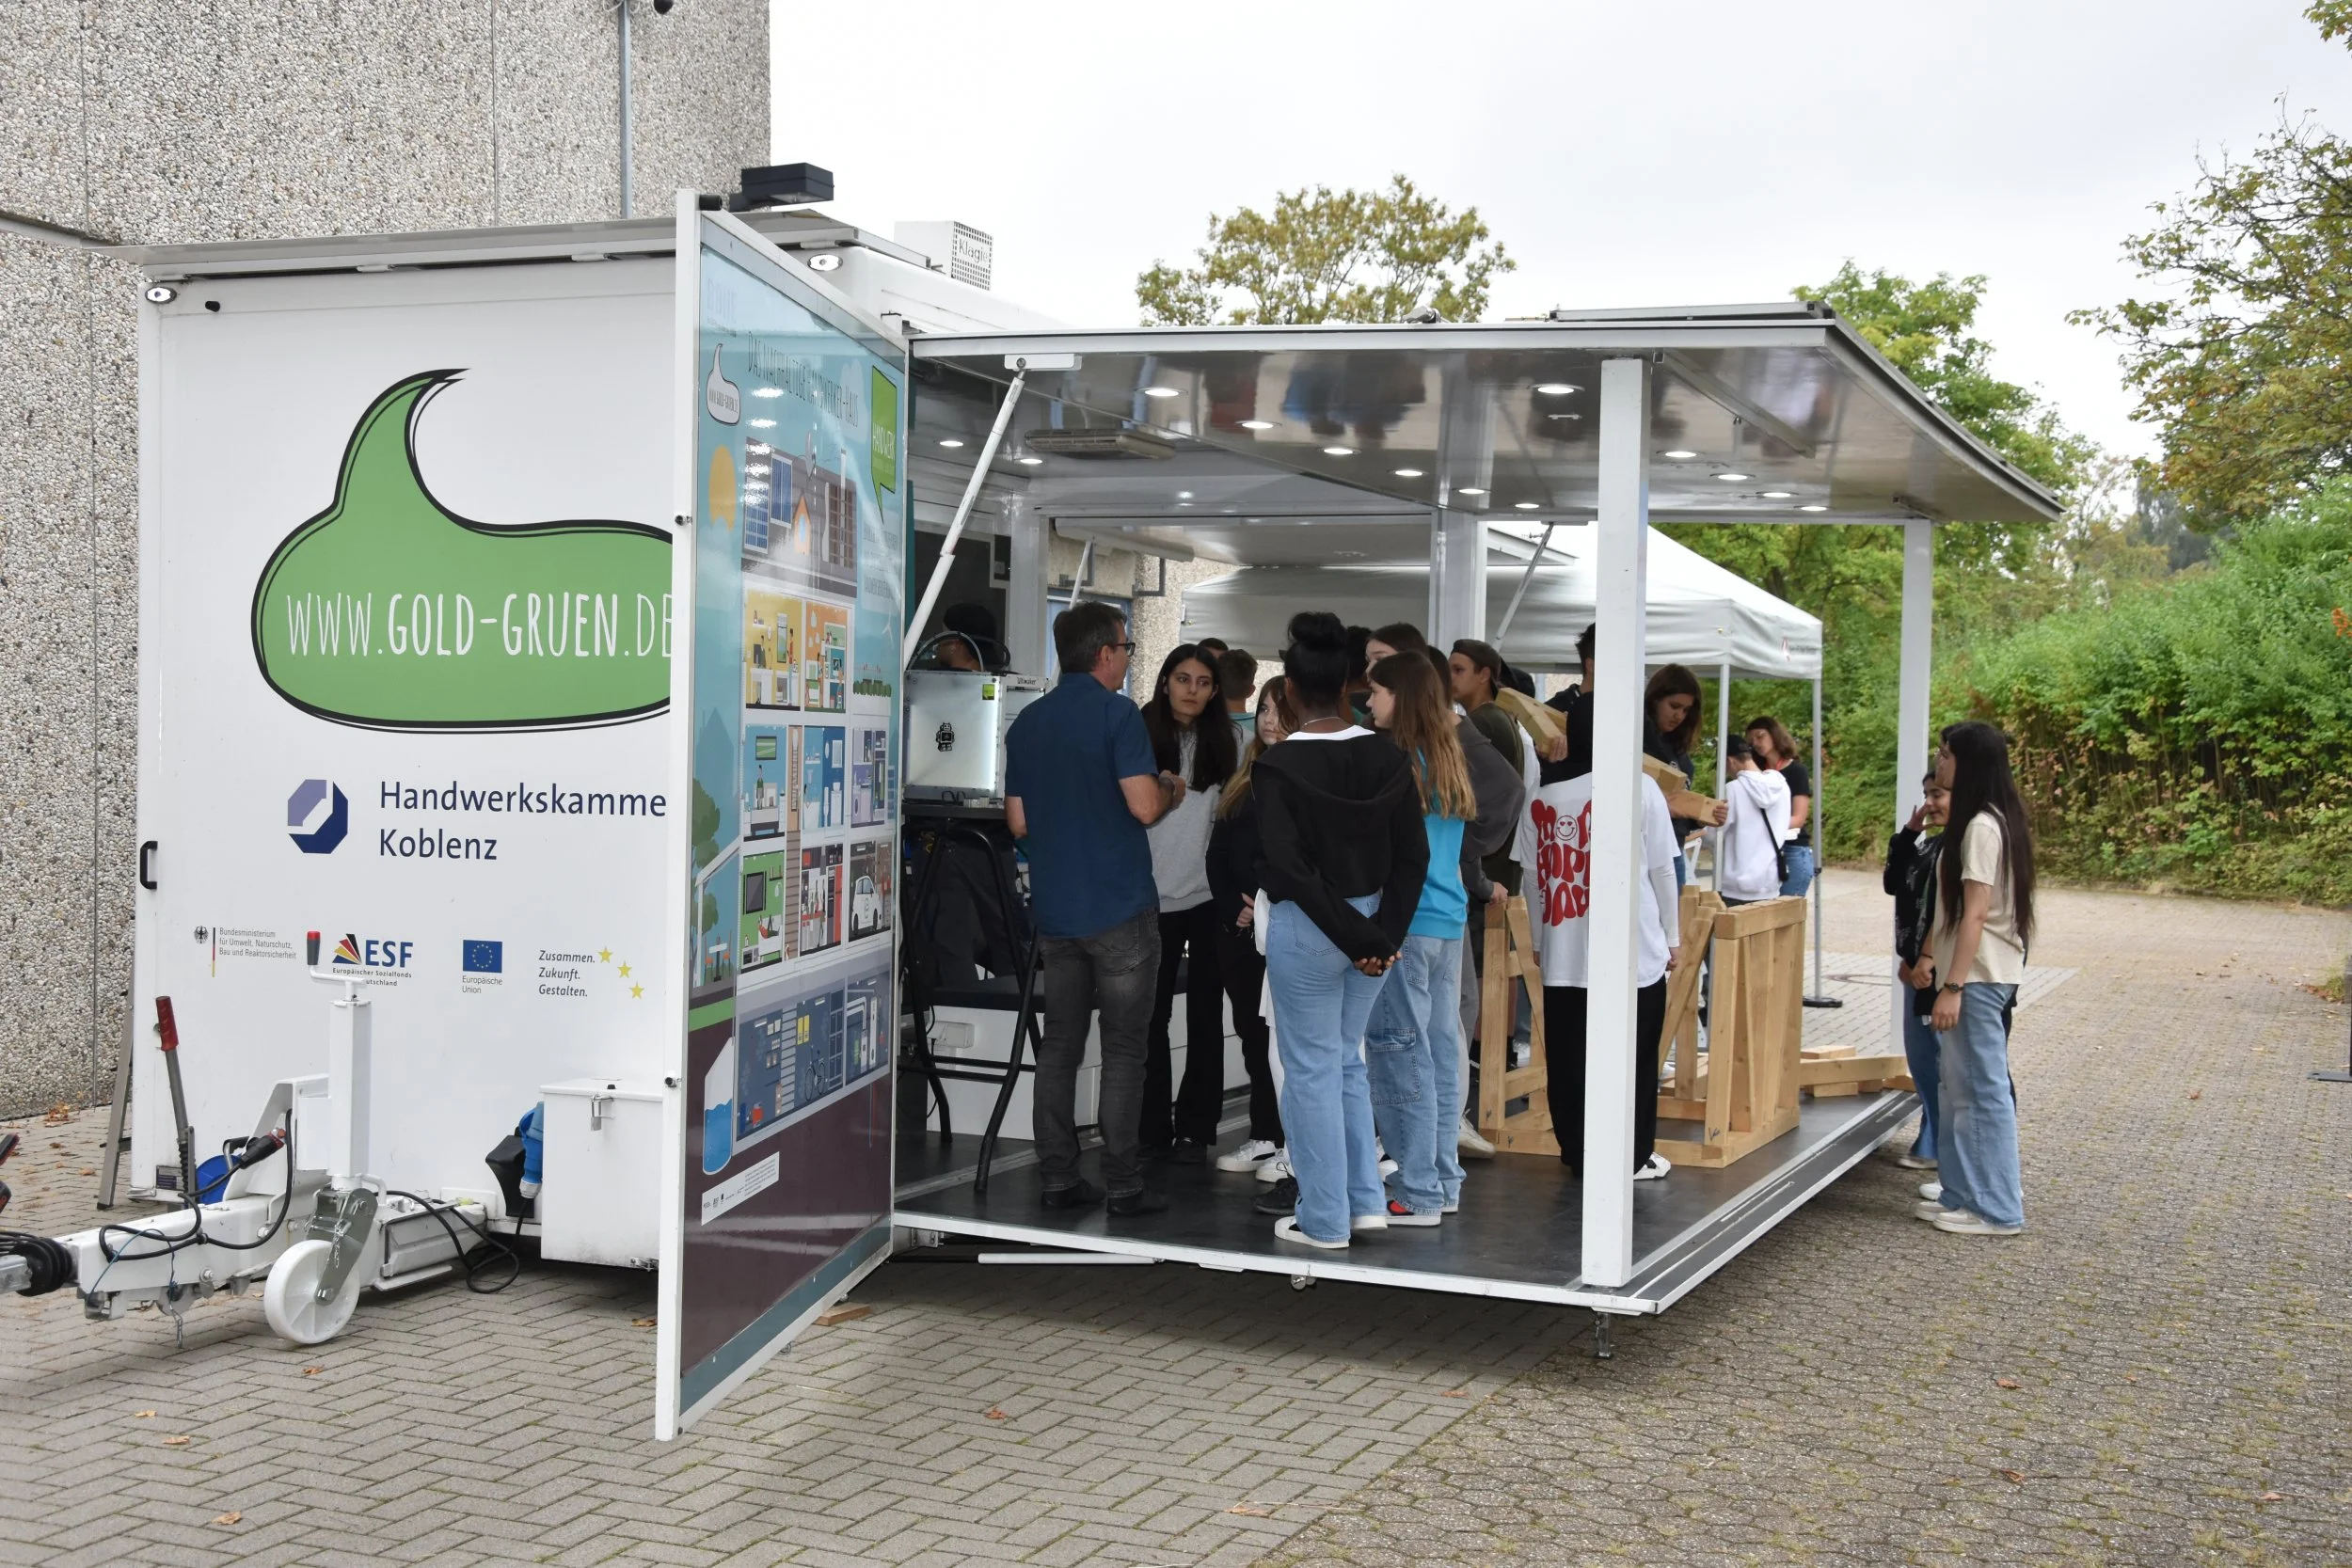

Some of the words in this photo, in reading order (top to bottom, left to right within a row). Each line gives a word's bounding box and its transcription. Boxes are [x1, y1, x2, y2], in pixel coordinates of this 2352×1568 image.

[286, 592, 672, 657] WWW.GOLD-GRUEN.DE
[380, 780, 667, 817] Handwerkskamme
[379, 827, 498, 860] Koblenz
[219, 927, 276, 938] Bundesministerium
[255, 940, 293, 950] Naturschutz,
[219, 947, 230, 956] Bau
[231, 948, 244, 957] und
[245, 949, 296, 959] Reaktorsicherheit
[365, 939, 414, 968] ESF
[538, 950, 596, 963] Zusammen.
[332, 967, 373, 976] Europäischer
[375, 970, 412, 978] Sozialfonds
[538, 967, 580, 982] Zukunft.
[366, 978, 398, 987] utschland
[462, 975, 503, 986] Europäische
[538, 984, 588, 997] Gestalten.
